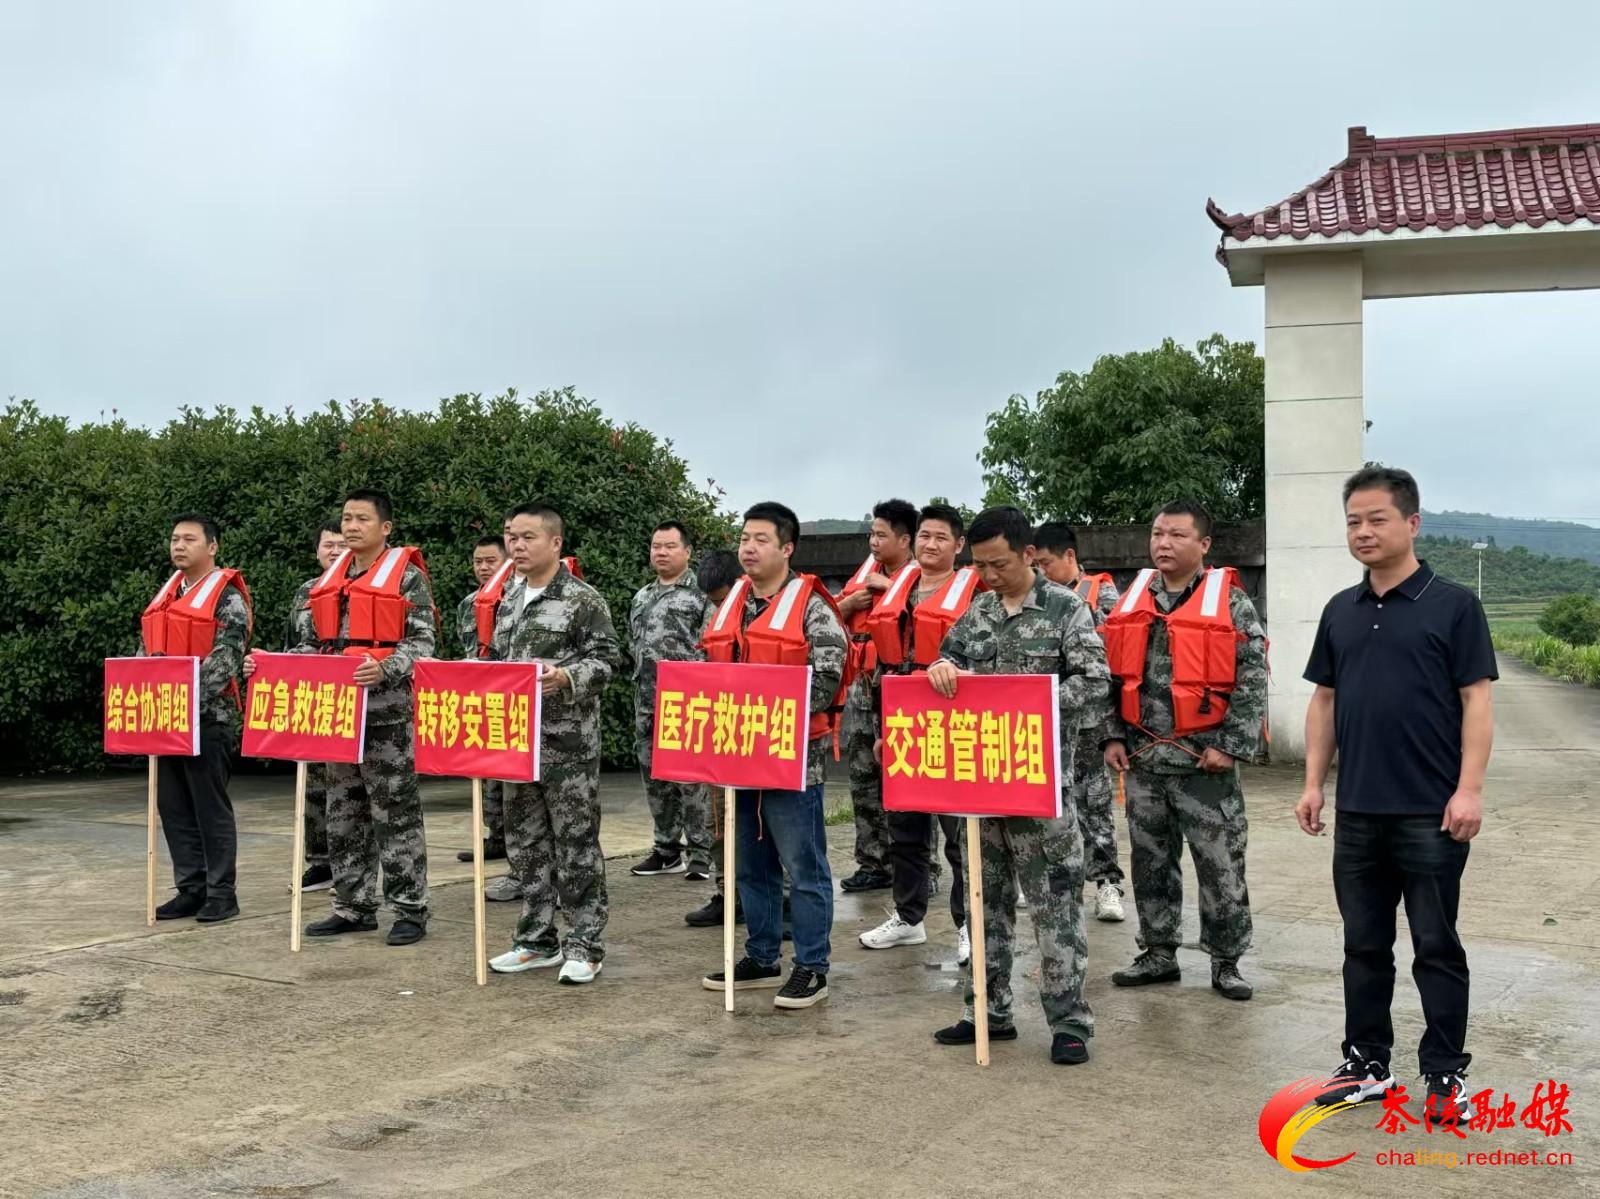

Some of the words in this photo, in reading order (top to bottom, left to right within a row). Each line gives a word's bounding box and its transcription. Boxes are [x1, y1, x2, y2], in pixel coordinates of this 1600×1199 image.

[107, 682, 189, 733] 综合协调组
[248, 677, 358, 739] 应急救援组
[417, 686, 530, 753] 转移安置组
[657, 690, 797, 760] 医疗救护组
[885, 708, 1047, 785] 交通管制组
